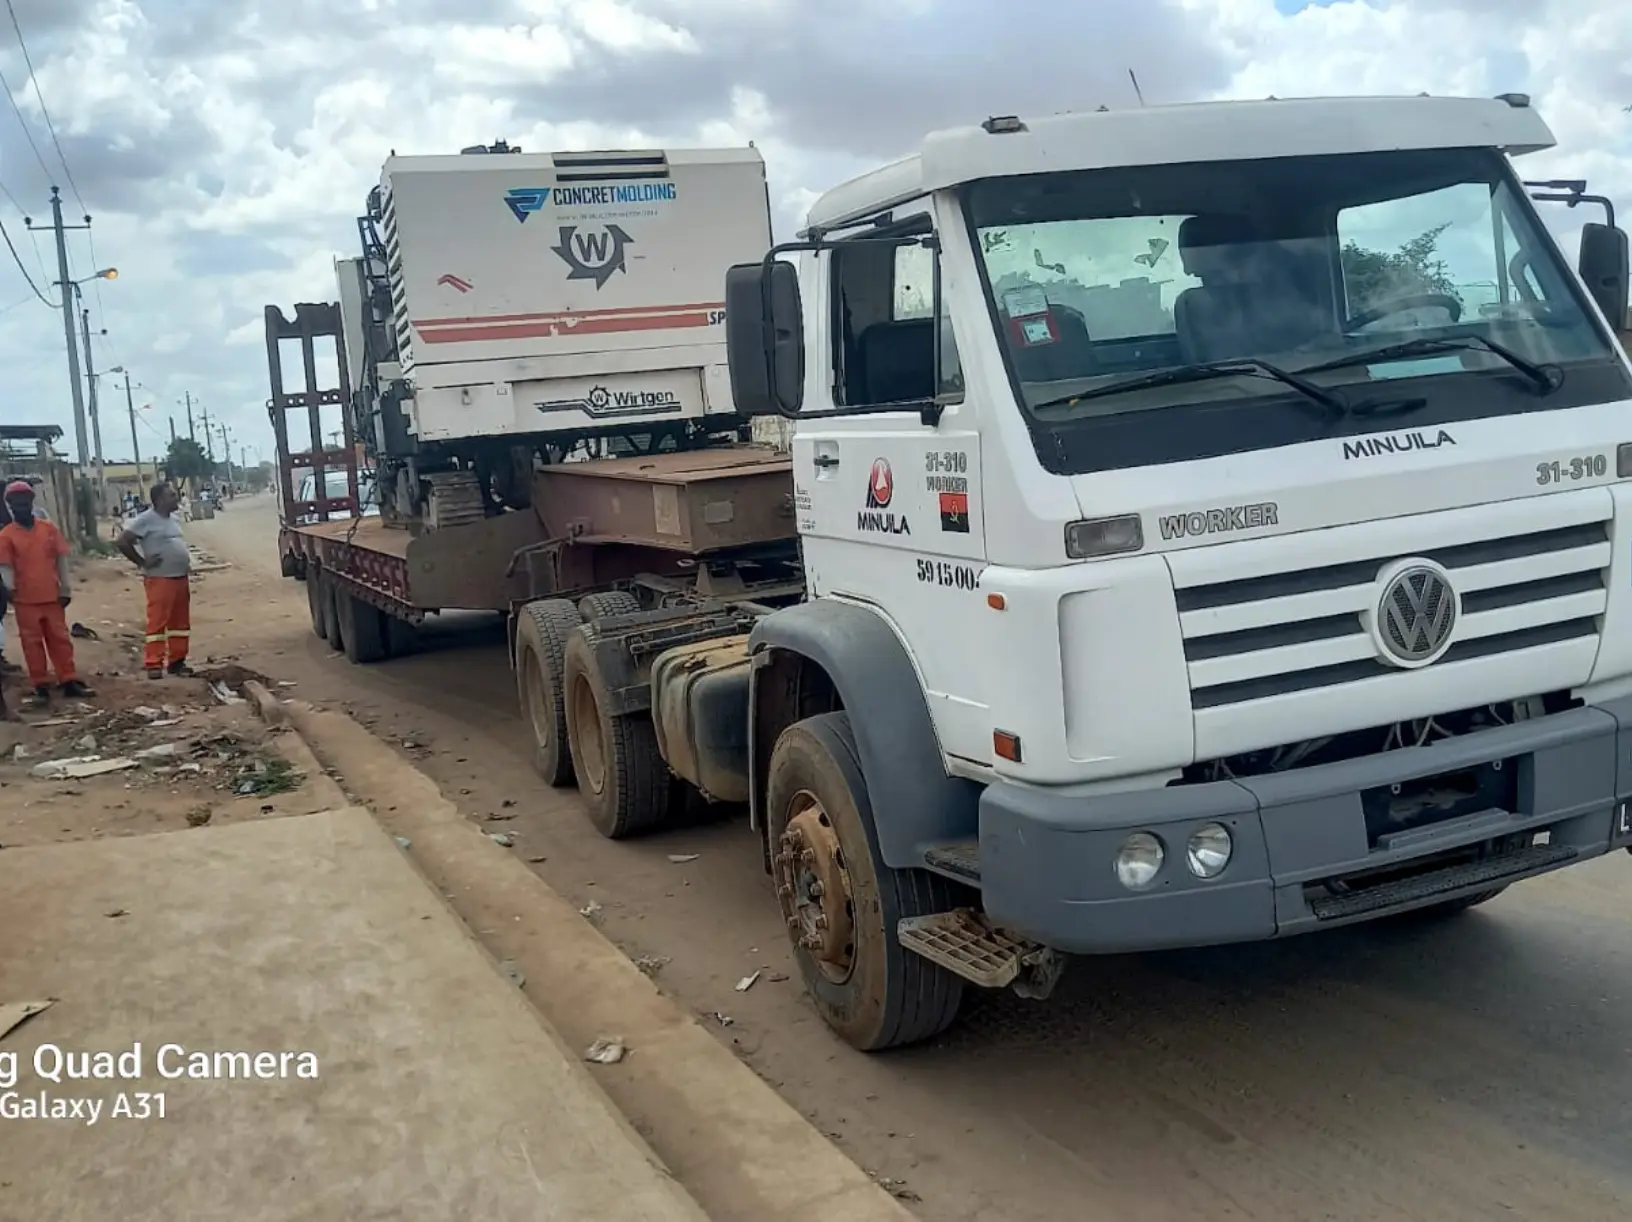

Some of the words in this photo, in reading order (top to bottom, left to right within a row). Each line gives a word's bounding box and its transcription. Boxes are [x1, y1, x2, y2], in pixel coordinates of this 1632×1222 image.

[553, 183, 676, 206] CONCRETMOLDING
[613, 391, 674, 406] Wirtgen
[1343, 430, 1456, 460] MINUILA
[925, 451, 967, 473] 31-310
[1536, 455, 1607, 485] 31-310
[926, 475, 967, 492] WORKER
[857, 511, 911, 535] MINUILA
[1160, 502, 1279, 540] WORKER
